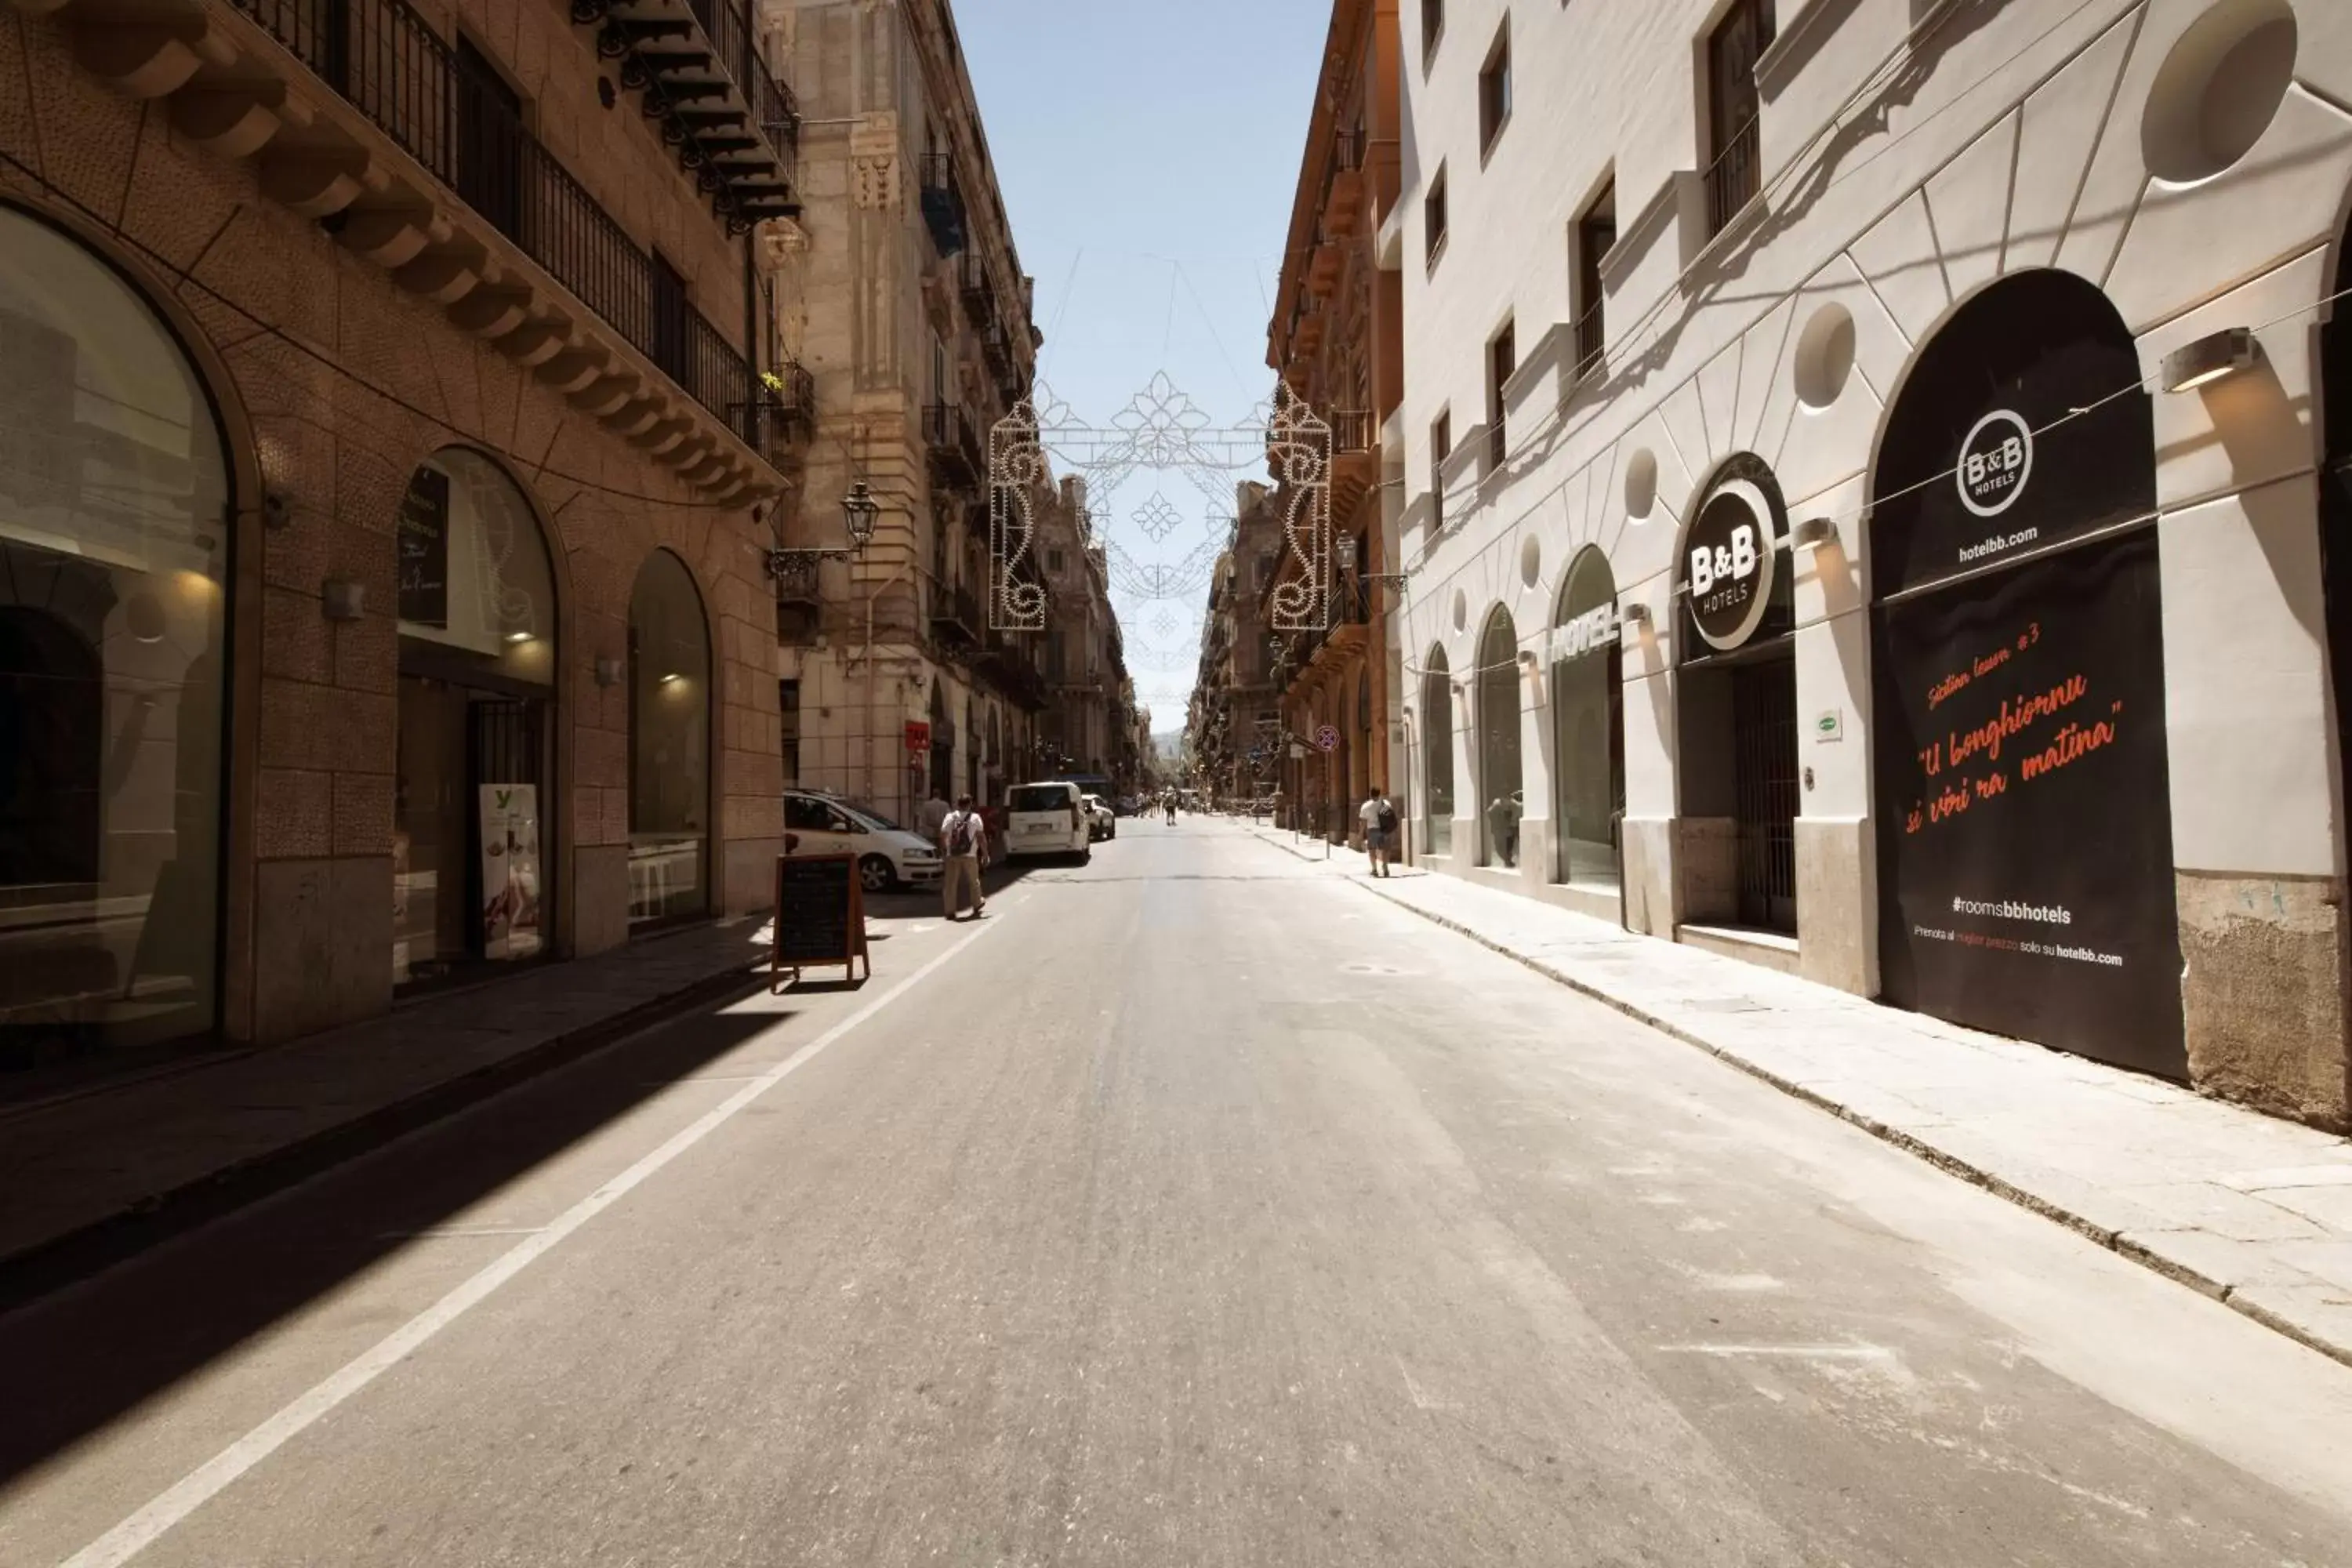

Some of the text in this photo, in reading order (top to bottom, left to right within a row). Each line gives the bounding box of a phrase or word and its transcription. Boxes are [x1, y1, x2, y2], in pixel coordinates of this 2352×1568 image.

[1967, 437, 2023, 485] B&B
[1975, 472, 2016, 496] HOTELS
[1959, 525, 2038, 563] hotelbb.com
[1691, 524, 1757, 597] B&B
[1704, 583, 1748, 615] HOTELS
[1952, 896, 2071, 925] #roomsbbhotels
[2020, 941, 2041, 954] solo
[2043, 944, 2056, 956] su
[2056, 944, 2123, 967] hotelbb.com
